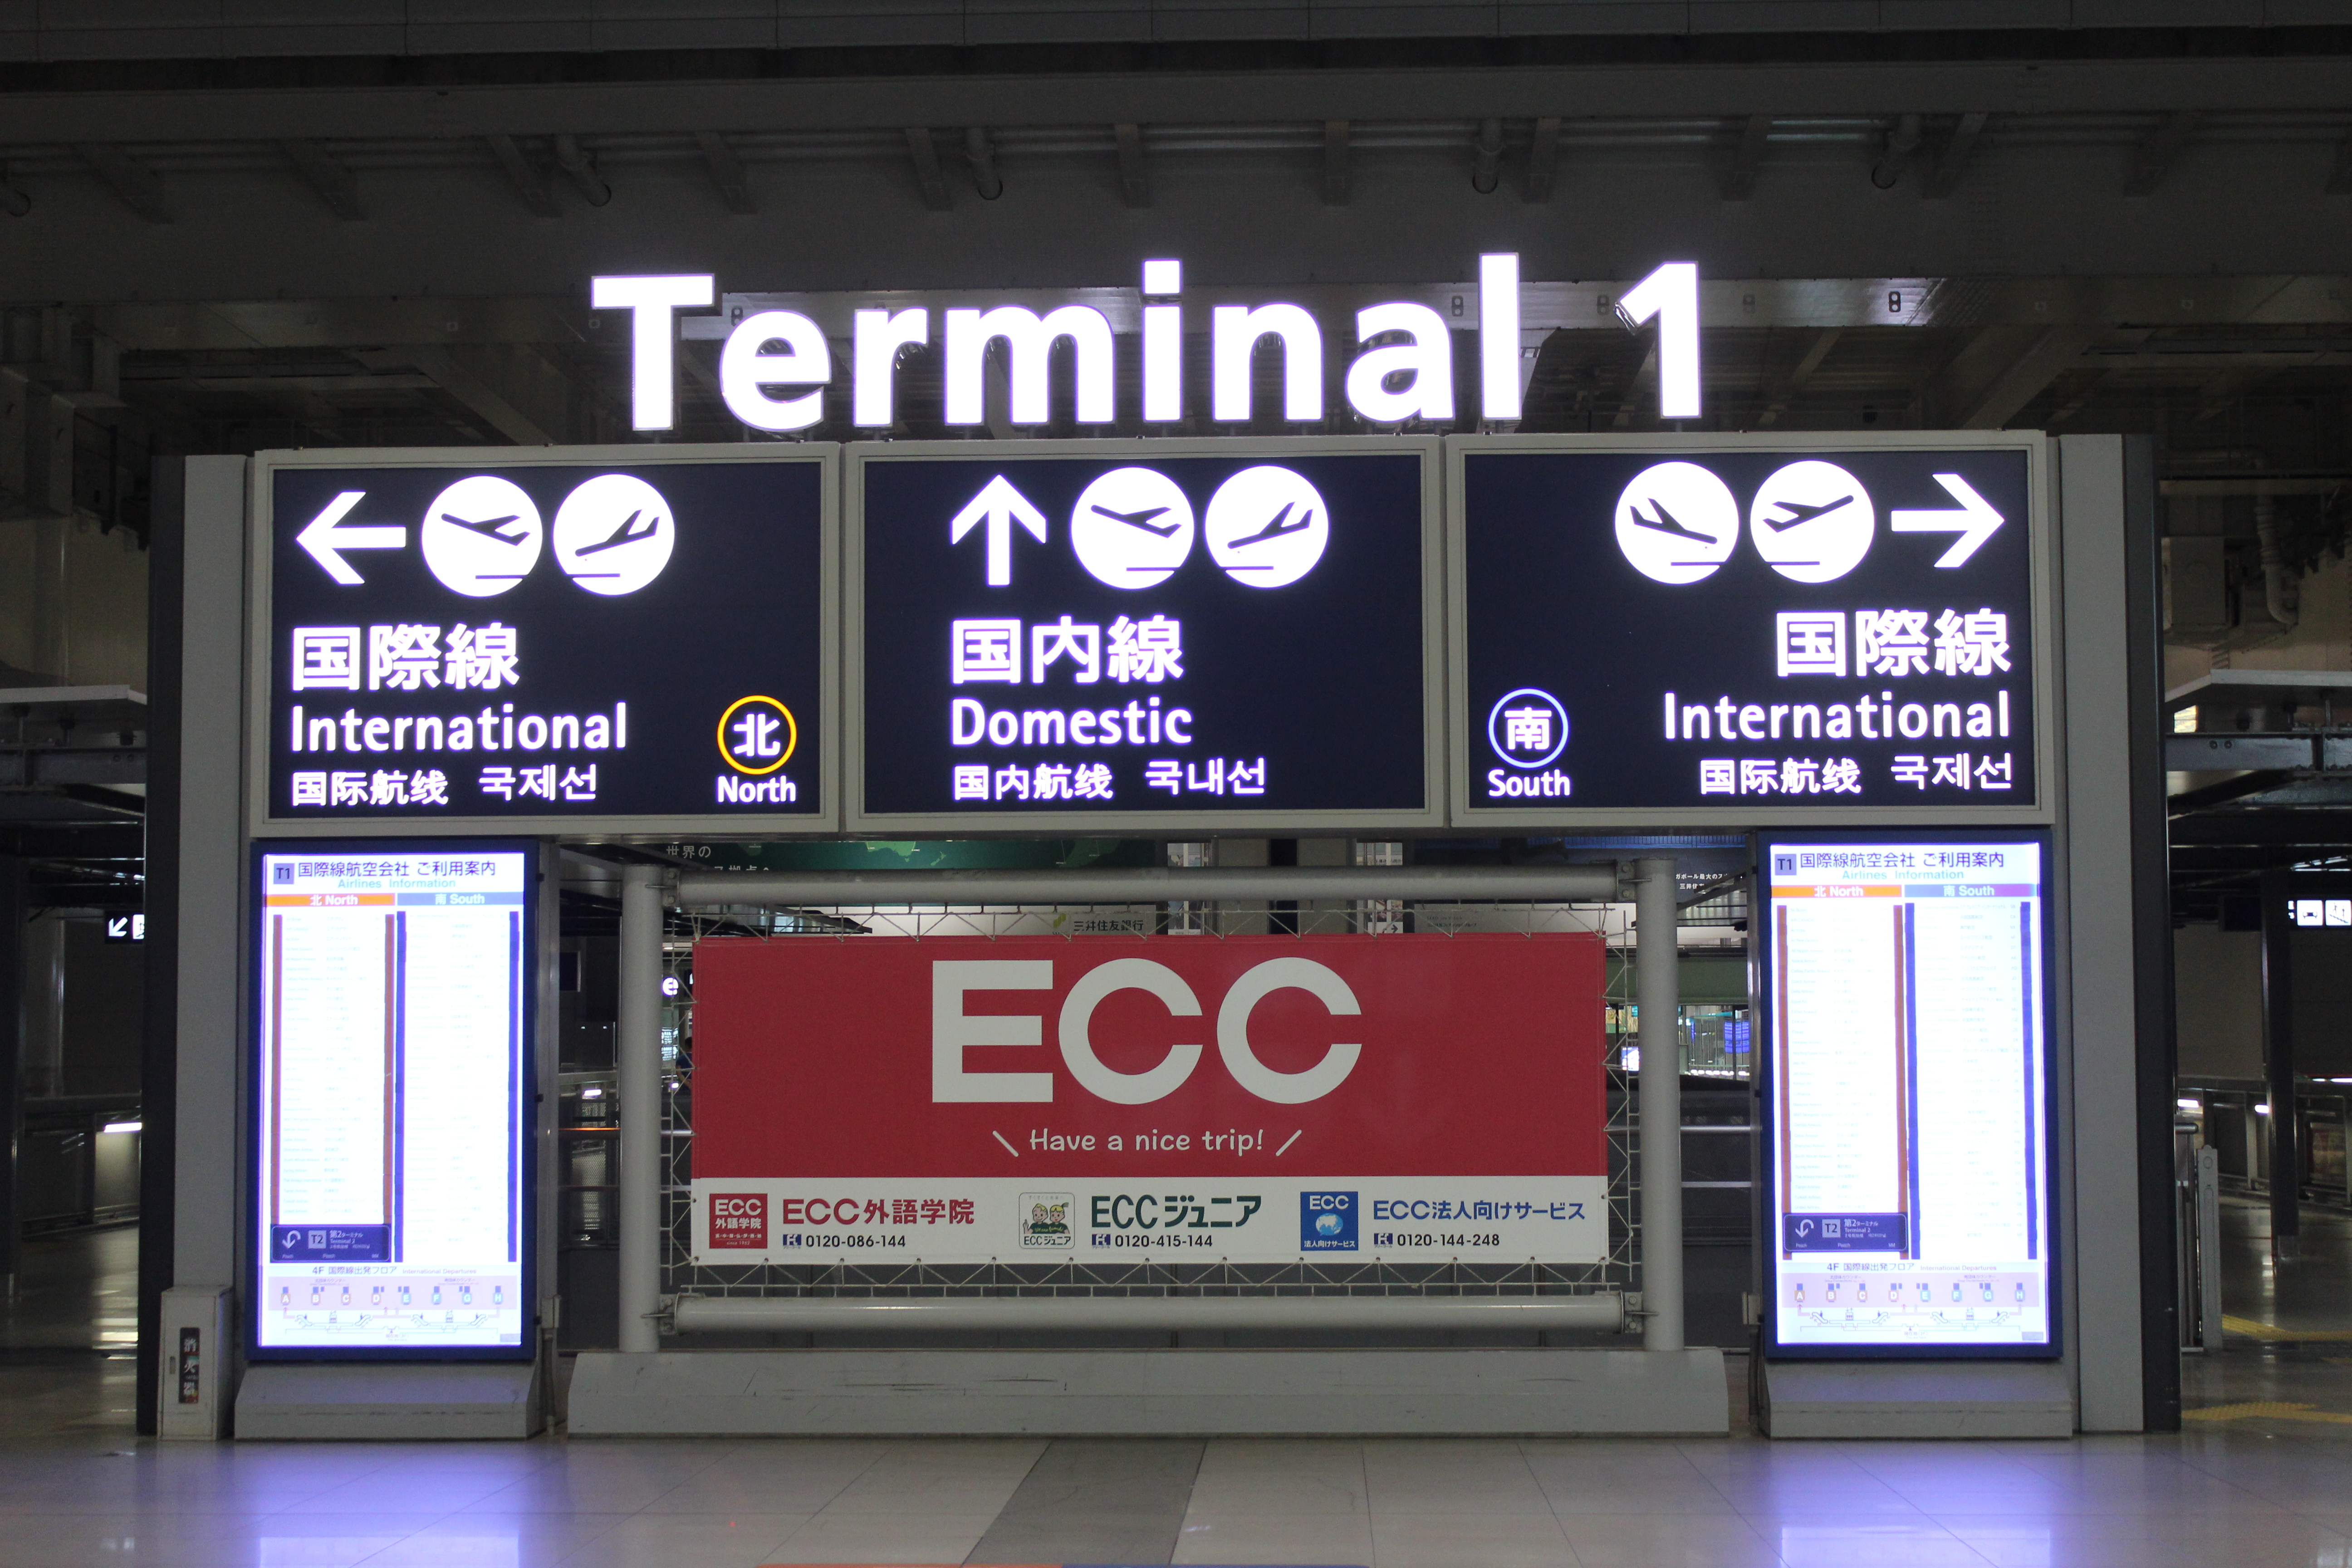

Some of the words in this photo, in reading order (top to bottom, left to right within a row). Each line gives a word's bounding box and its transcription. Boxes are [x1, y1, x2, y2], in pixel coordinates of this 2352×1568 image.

[590, 252, 1523, 433] Terminal
[1618, 261, 1703, 421] 1
[951, 615, 1184, 684] 国内線
[1776, 608, 2012, 677] 国際線
[292, 622, 520, 691] 国際線
[951, 697, 1192, 745] Domestic
[1664, 691, 2009, 740] International
[292, 701, 627, 751] International
[1504, 707, 1551, 750] 南
[733, 713, 781, 757] 北
[1145, 758, 1266, 795] 국내선
[1700, 758, 1862, 795] 国际航线
[1890, 753, 2013, 790] 국제선
[292, 769, 448, 806] 国际航线
[478, 763, 597, 801] 국제선
[717, 774, 797, 802] North
[954, 764, 1113, 800] 国内航线
[1488, 769, 1570, 799] South
[666, 845, 710, 858] 世界の
[1778, 858, 1793, 870] T1
[1801, 853, 1915, 868] 国際線航空会社
[1923, 852, 2004, 867] ご利用案内
[276, 867, 290, 879] T1
[299, 862, 409, 877] 国際線航空会社
[417, 860, 495, 877] ご利用案内
[1842, 870, 1887, 880] Airlines
[1895, 870, 1964, 879] Information
[338, 879, 382, 888] Airlines
[389, 878, 456, 888] Information
[435, 894, 446, 904] 南
[450, 894, 485, 904] South
[1814, 886, 1826, 897] 北
[1830, 886, 1863, 897] North
[1944, 886, 1955, 897] 南
[1959, 886, 1994, 896] South
[310, 895, 322, 906] 北
[325, 894, 358, 905] North
[1074, 920, 1144, 931] 三井住友銀行
[931, 957, 1362, 1105] ECC
[1030, 1127, 1096, 1151] Have
[1107, 1136, 1123, 1151] a
[1135, 1129, 1190, 1151] nice
[1201, 1128, 1264, 1157] trip!
[715, 1199, 762, 1215] ECC
[1309, 1195, 1349, 1210] ECC
[1373, 1200, 1585, 1220] ECC法人向けサービス
[783, 1198, 975, 1225] ECC外語学院
[715, 1217, 761, 1229] 外語学院
[1825, 1223, 1838, 1233] T2
[1844, 1219, 1878, 1227] 第2ターミナル
[311, 1235, 323, 1244] T2
[805, 1235, 906, 1248] 0120-086-144
[1115, 1235, 1213, 1247] 0120-415-144
[1397, 1233, 1500, 1246] 0120-144-248
[312, 1267, 324, 1275] 4F
[328, 1266, 397, 1275] 国際線出発フロア
[1843, 1263, 1915, 1271] 国際線出発フロア
[281, 1294, 290, 1303] A
[313, 1294, 319, 1303] B
[343, 1294, 349, 1303] C
[373, 1294, 380, 1303] D
